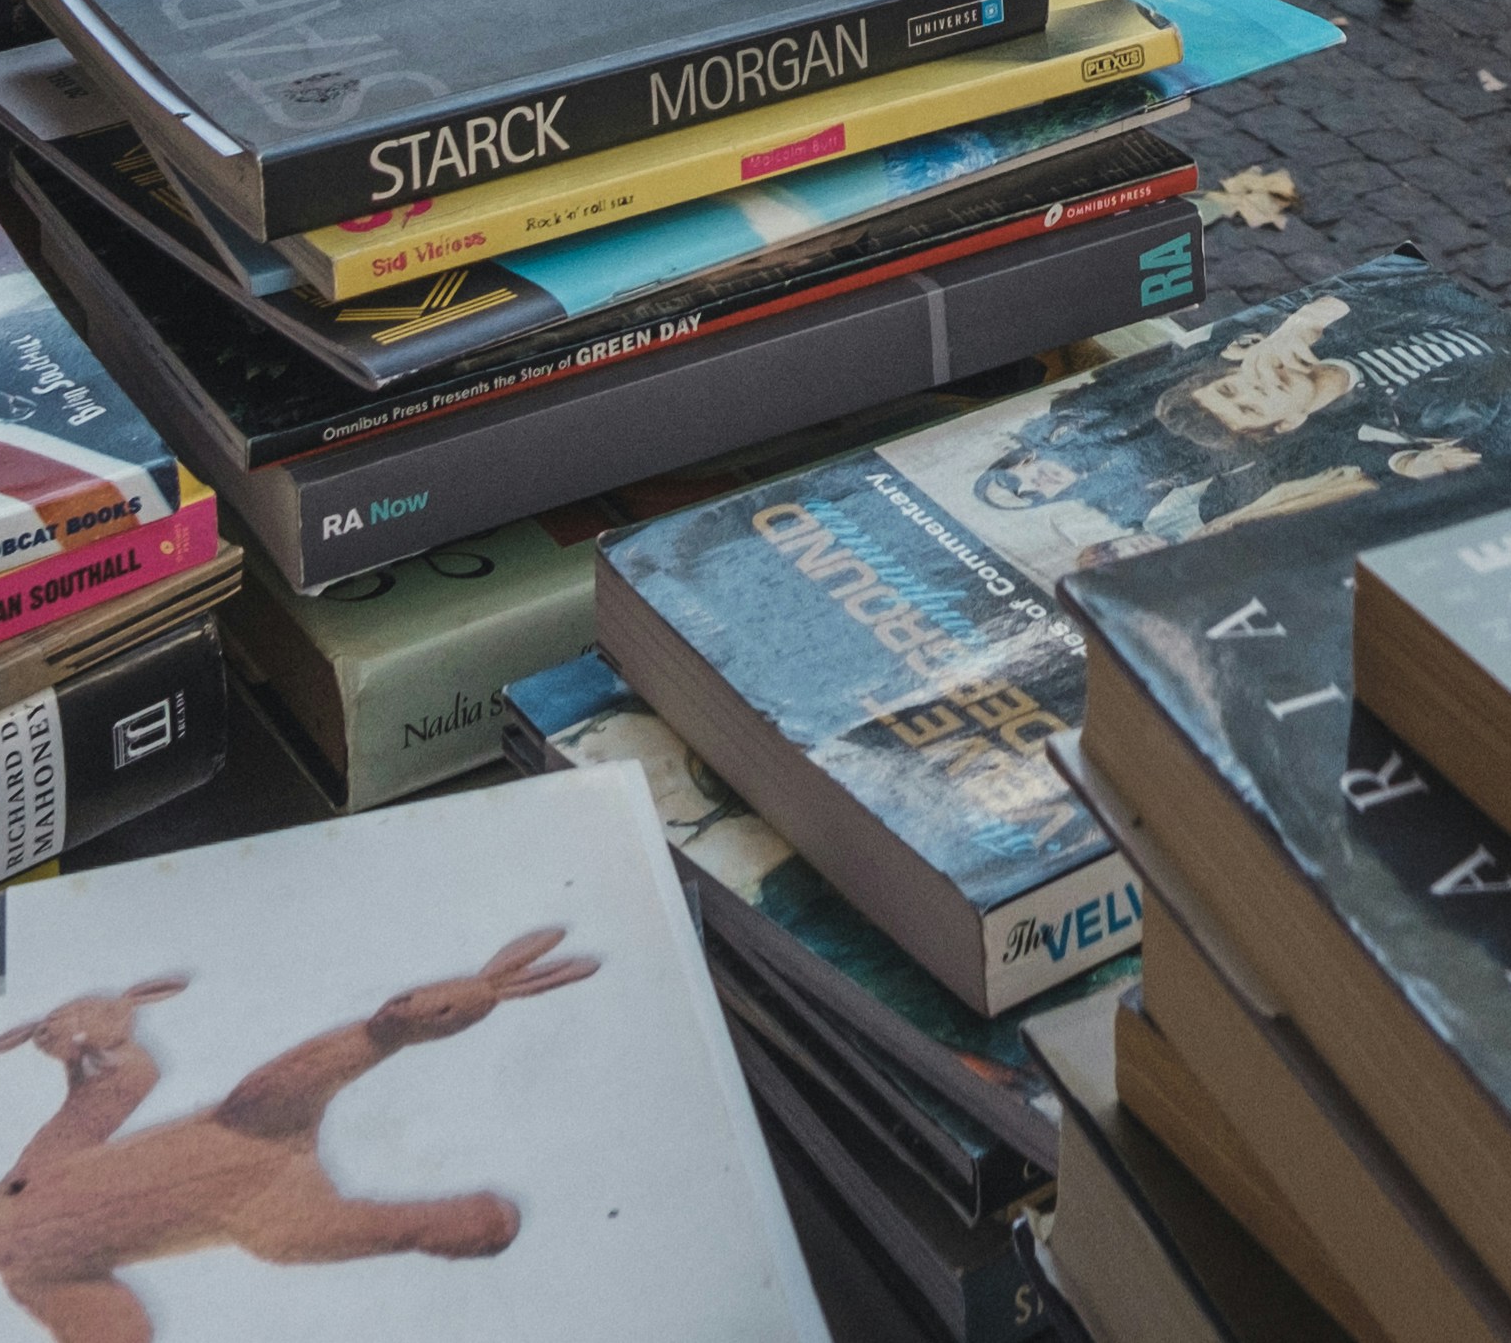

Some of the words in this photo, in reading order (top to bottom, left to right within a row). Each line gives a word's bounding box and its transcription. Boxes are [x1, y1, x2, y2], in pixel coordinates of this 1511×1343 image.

[369, 94, 571, 203] STARCK
[649, 15, 869, 127] MORGAN
[914, 8, 979, 38] UNIVERSE
[372, 250, 408, 278] Sid
[1085, 49, 1142, 77] PLEXUS
[322, 411, 389, 442] Omnibus
[392, 399, 429, 421] Press
[431, 380, 491, 409] Presents
[493, 369, 517, 389] the
[519, 360, 554, 383] Story
[557, 354, 572, 371] of
[575, 329, 653, 368] GREEN
[659, 312, 703, 342] DAY
[1065, 195, 1118, 220] OMNIBUS
[1120, 185, 1153, 205] PRESS
[321, 507, 365, 541] RA
[368, 490, 430, 526] Now
[1140, 231, 1193, 308] RA
[66, 495, 143, 536] BOOKS
[865, 472, 1017, 598] Commentary
[29, 548, 143, 611] SOUTHALL
[1009, 596, 1048, 621] of
[25, 700, 55, 854] MAHONEY
[401, 690, 483, 750] Nadia
[0, 750, 25, 872] RICHARD
